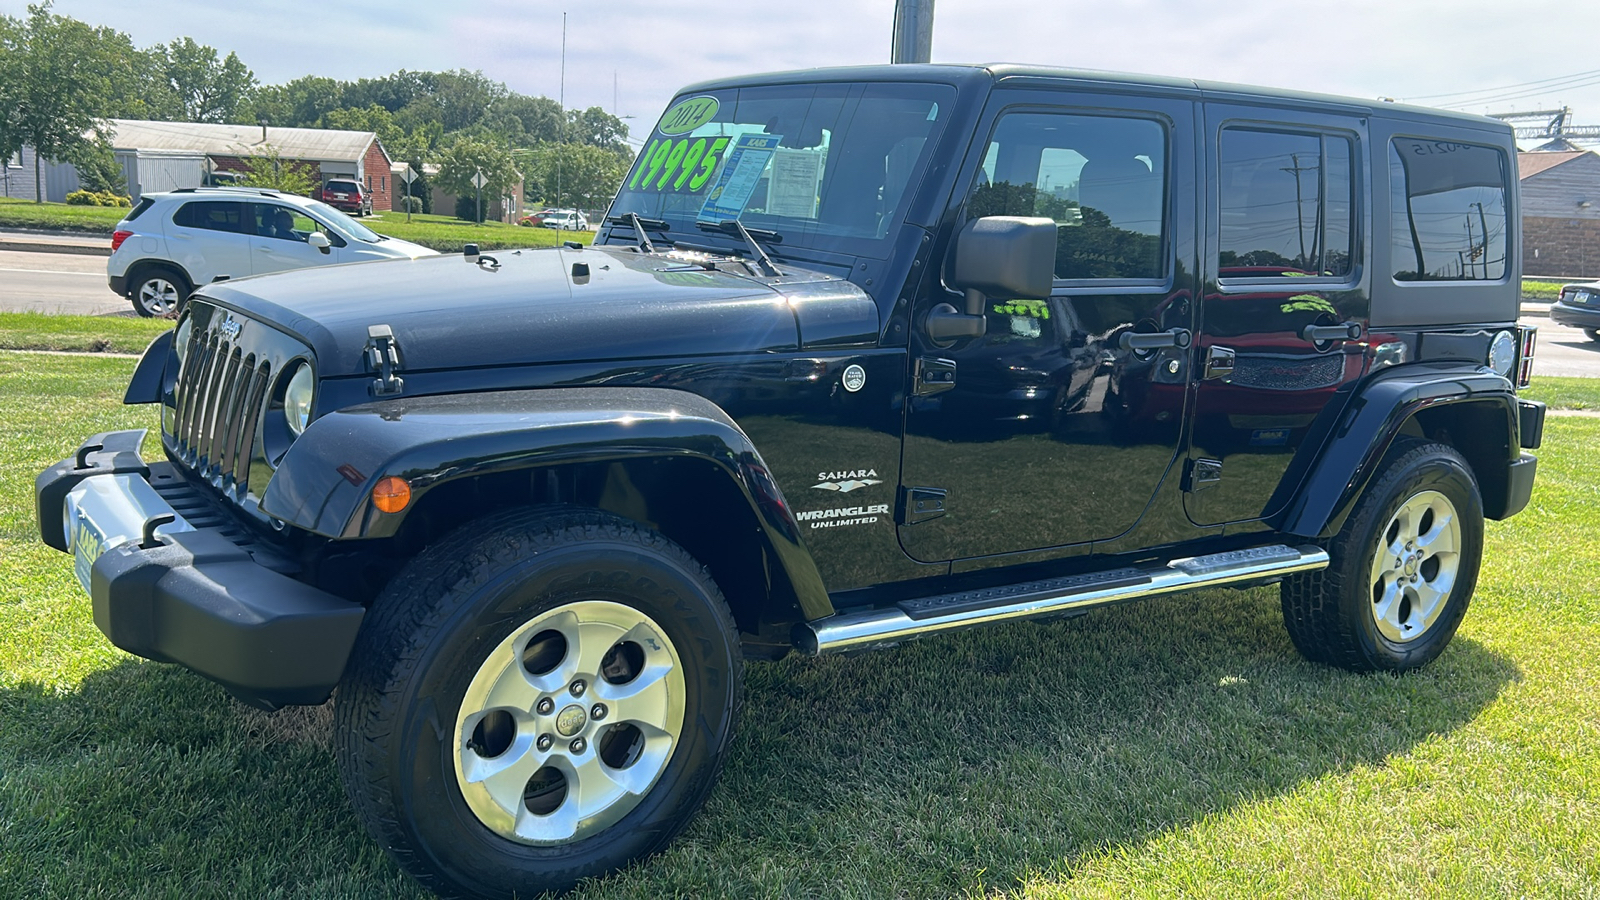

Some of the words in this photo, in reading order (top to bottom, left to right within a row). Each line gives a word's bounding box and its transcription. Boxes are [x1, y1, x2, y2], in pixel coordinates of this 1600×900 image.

[664, 101, 714, 130] 2014
[629, 138, 729, 192] 19995
[222, 314, 241, 338] Jeep
[818, 469, 878, 480] SAHARA
[796, 504, 889, 520] WRANGLER
[811, 517, 878, 528] UNLIMITED
